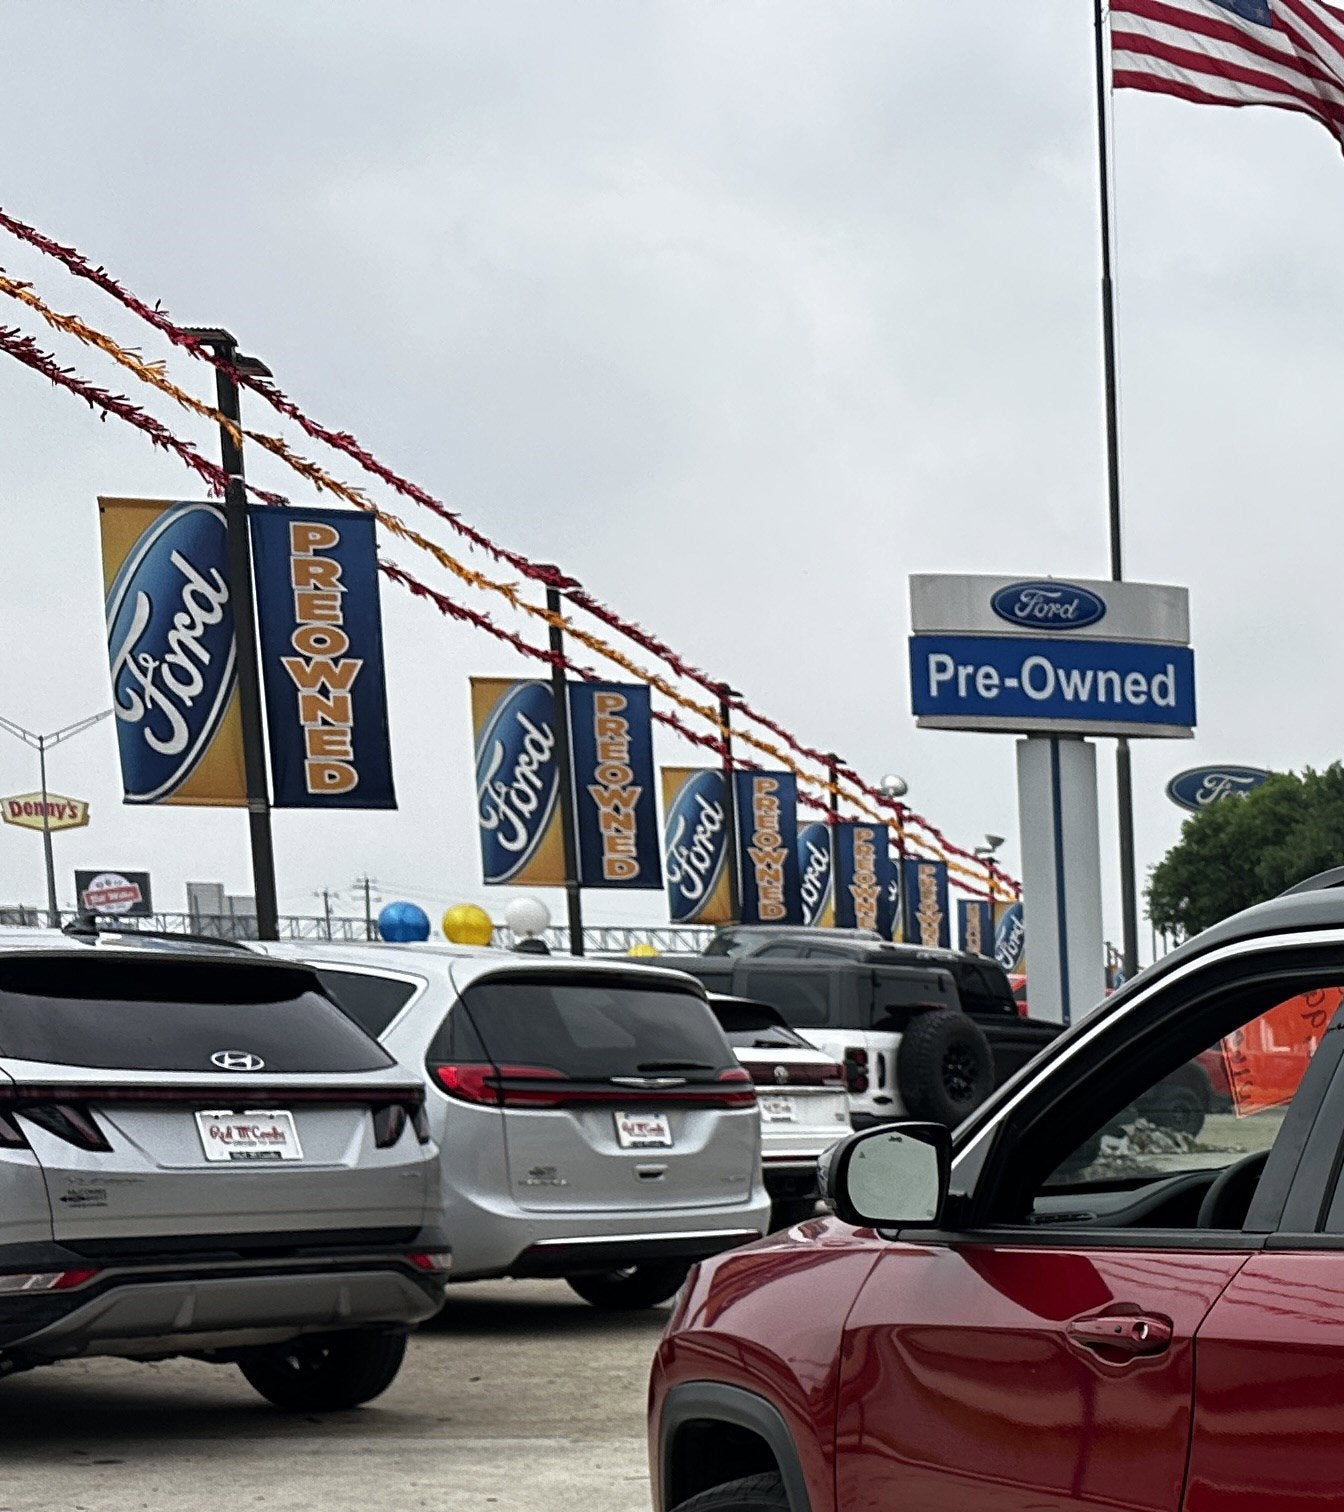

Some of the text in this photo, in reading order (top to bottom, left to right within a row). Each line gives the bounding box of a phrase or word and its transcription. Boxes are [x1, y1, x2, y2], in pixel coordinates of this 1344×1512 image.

[112, 549, 230, 755] Ford
[281, 520, 364, 795] PREOWNED
[1013, 588, 1079, 621] Ford
[927, 652, 1176, 707] Pre-Owned
[8, 800, 78, 820] Denny's
[479, 711, 555, 852] Ford
[587, 691, 642, 880] PREOWNED
[666, 792, 724, 900] Ford
[747, 776, 788, 920] PREOWNED
[801, 841, 829, 926] ord
